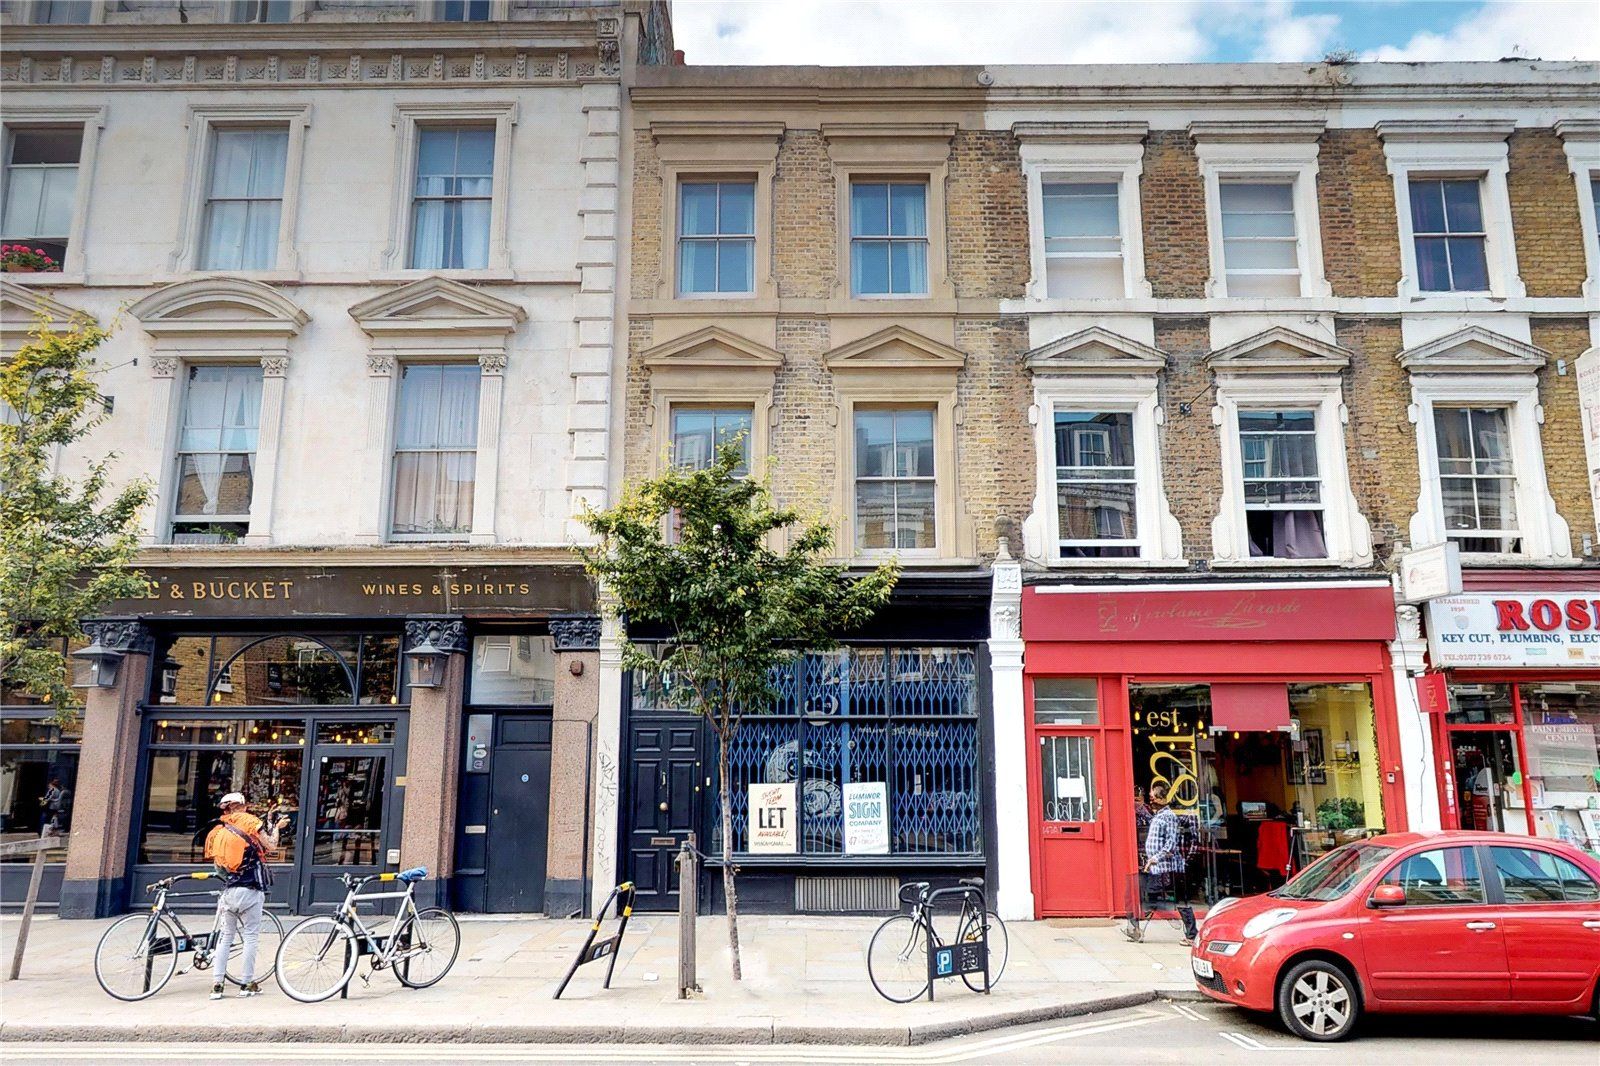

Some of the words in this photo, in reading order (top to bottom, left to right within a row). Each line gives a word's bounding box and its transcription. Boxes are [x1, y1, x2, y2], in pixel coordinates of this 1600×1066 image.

[170, 584, 184, 599] &
[193, 582, 294, 599] BUCKET
[362, 584, 422, 595] WINES
[432, 585, 442, 595] &
[450, 584, 530, 595] SPIRITS
[1442, 634, 1465, 643] KEY
[1469, 634, 1495, 645] CUT,
[1500, 634, 1564, 645] PLUMBING,
[1146, 708, 1188, 727] est.
[1531, 725, 1557, 733] PAINT
[849, 792, 881, 800] LUMINOR
[849, 801, 881, 819] SIGN
[758, 807, 787, 829] LET
